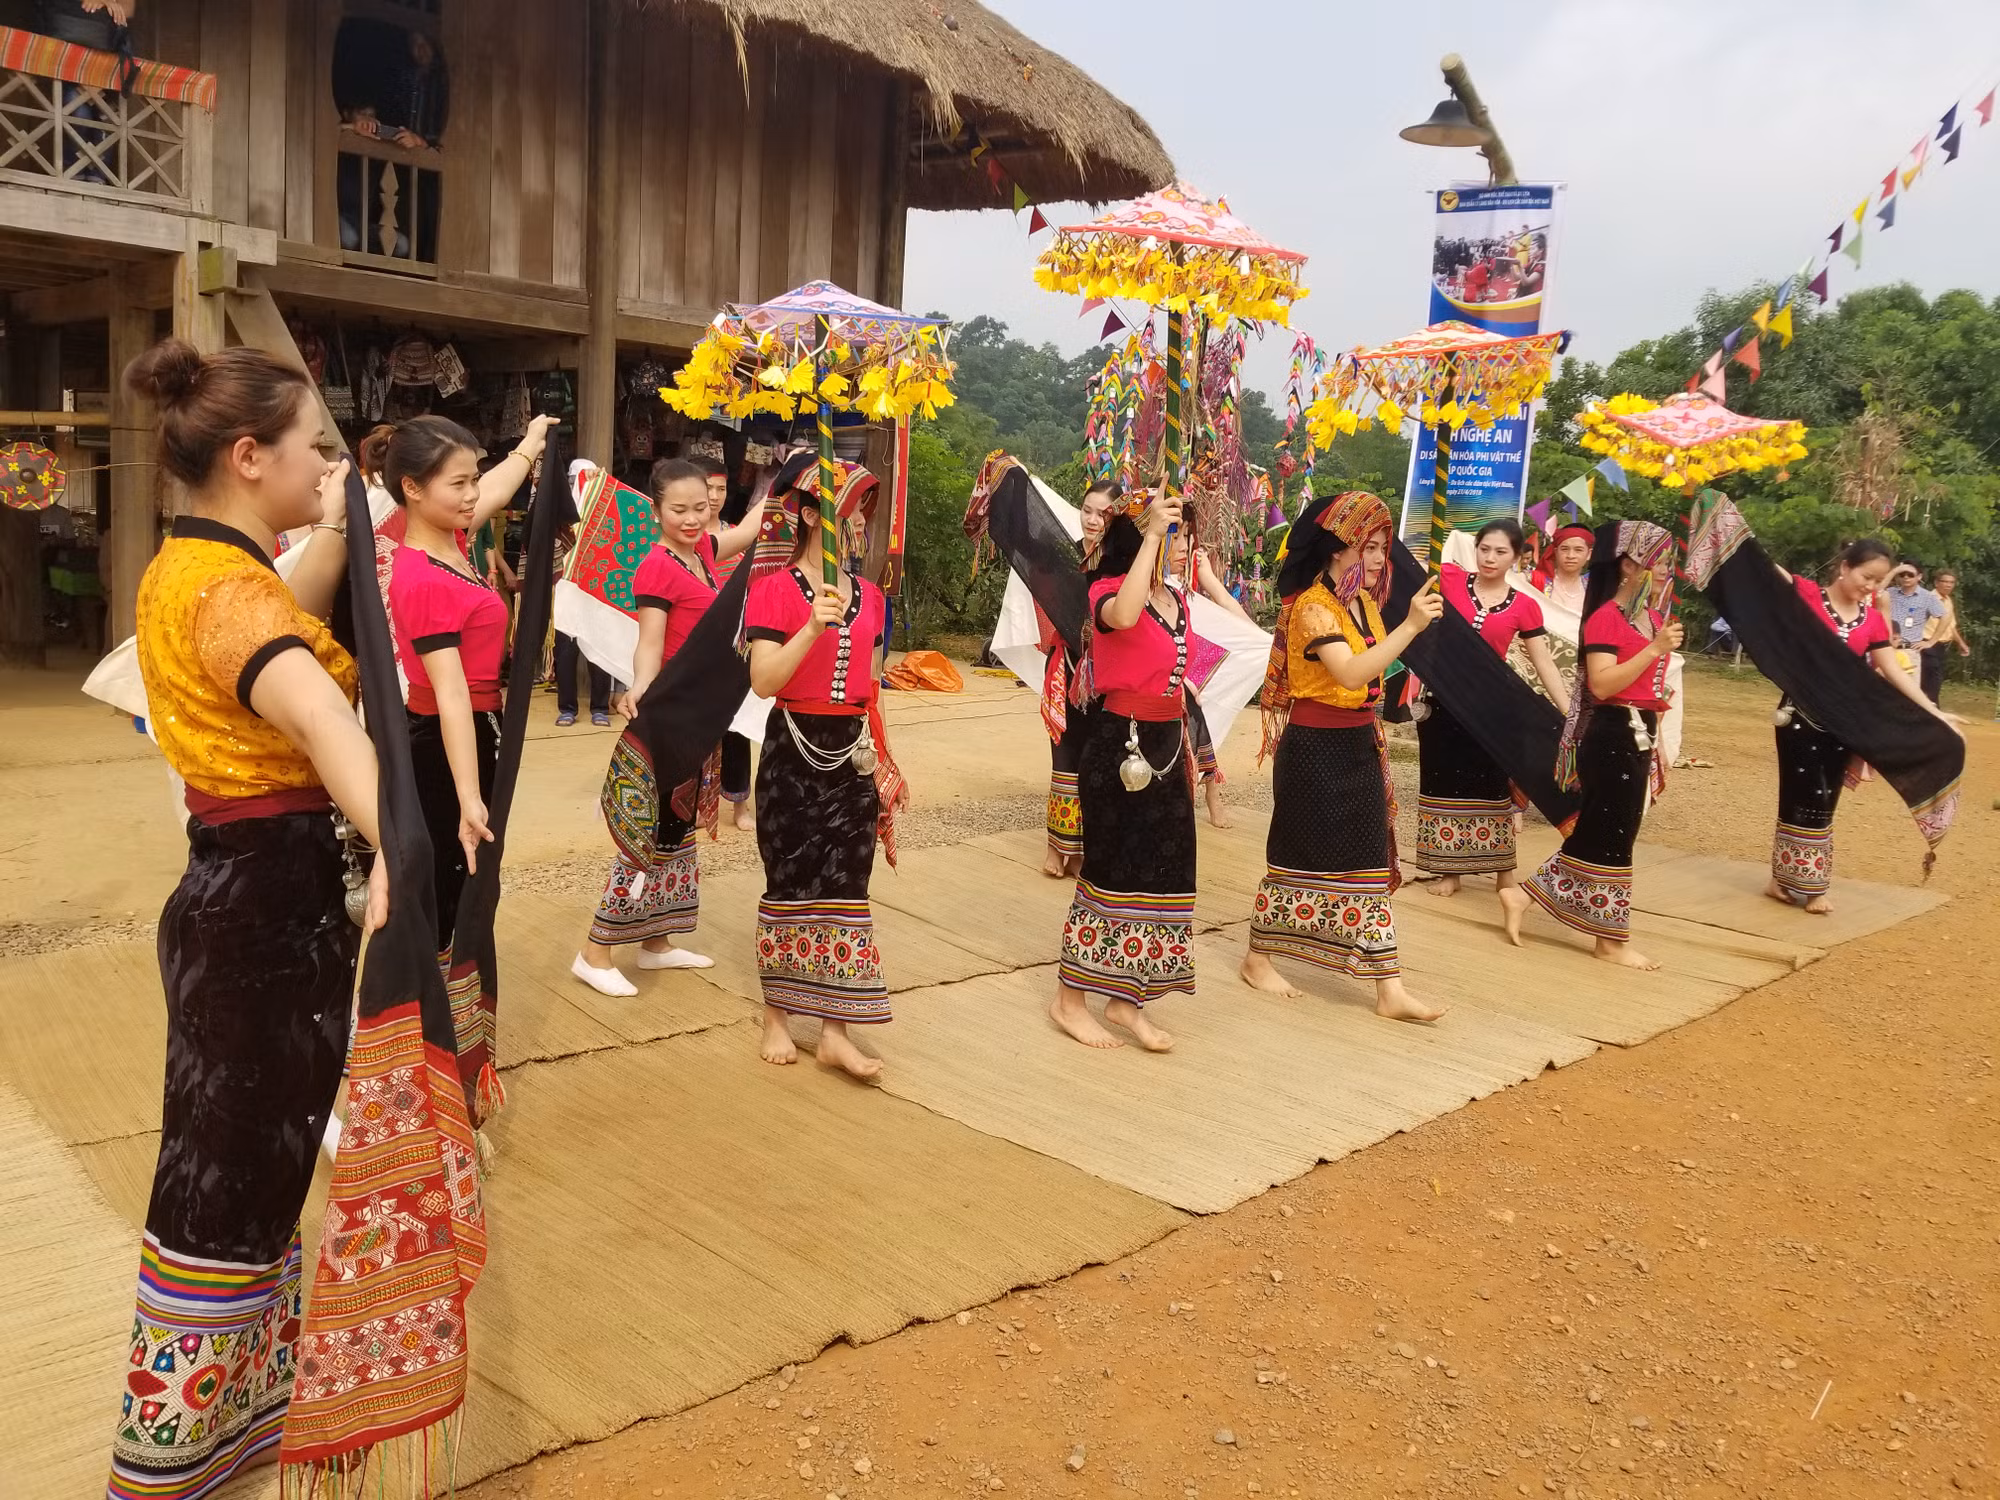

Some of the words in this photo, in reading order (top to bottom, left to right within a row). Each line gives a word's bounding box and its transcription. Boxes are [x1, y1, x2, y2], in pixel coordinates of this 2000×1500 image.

[1460, 428, 1492, 446] NGHỆ
[1493, 429, 1512, 443] AN
[1420, 450, 1428, 460] DI
[1476, 452, 1488, 461] PHI
[1490, 451, 1505, 464] VẬT
[1457, 463, 1478, 476] QUỐC
[1478, 466, 1492, 476] GIA
